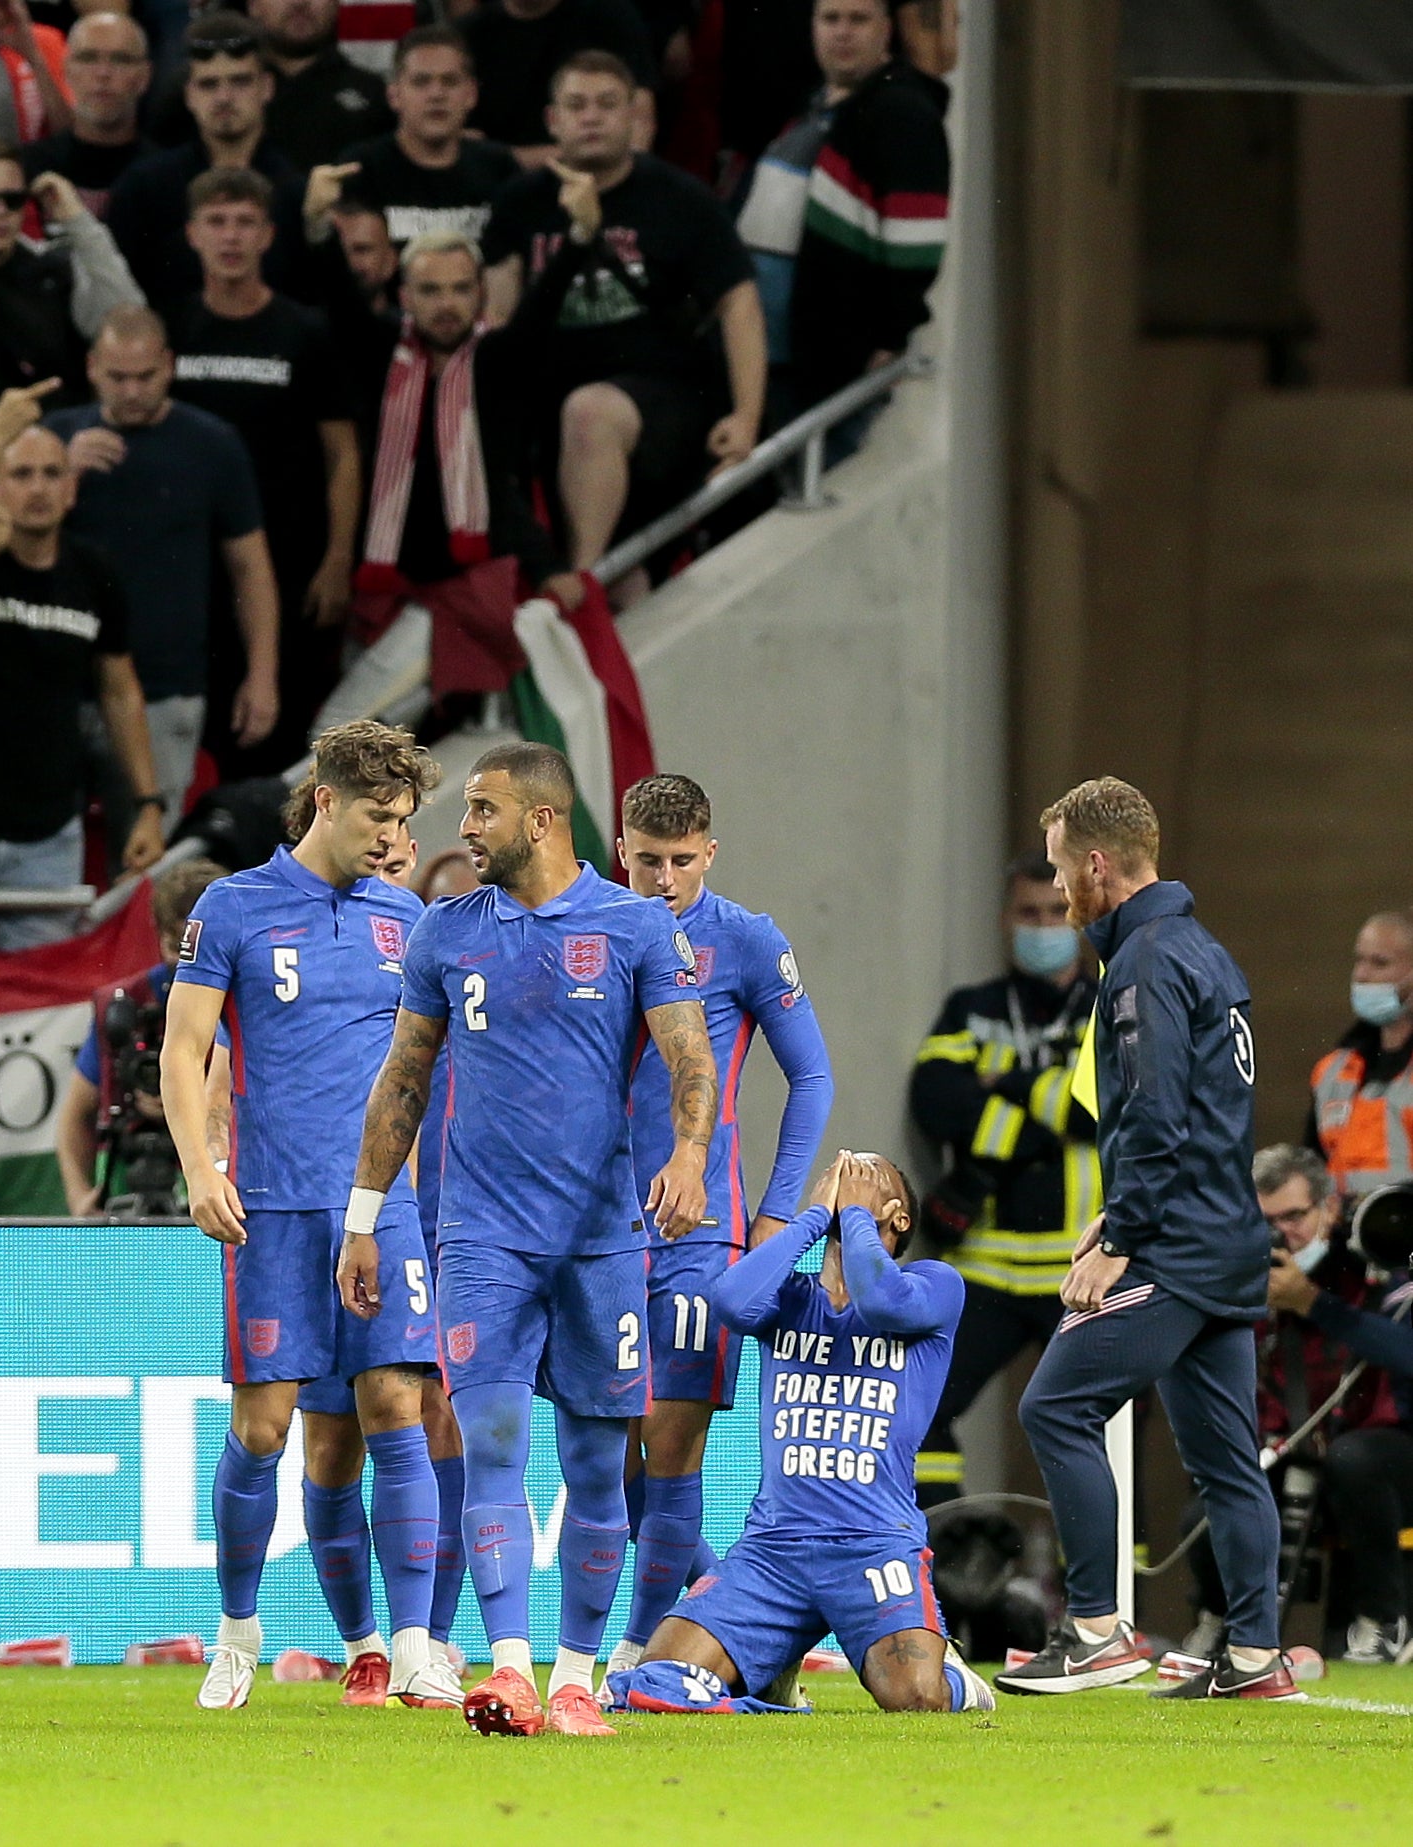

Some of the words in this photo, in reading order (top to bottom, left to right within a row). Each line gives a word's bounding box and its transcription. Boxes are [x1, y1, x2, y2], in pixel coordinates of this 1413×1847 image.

[273, 947, 300, 1003] 5
[463, 972, 487, 1031] 2
[403, 1259, 428, 1316] 5
[617, 1311, 640, 1371] 2
[673, 1293, 708, 1351] 11
[773, 1328, 834, 1366] LOVE
[851, 1336, 906, 1372] YOU
[773, 1372, 897, 1415] FOREVER
[773, 1407, 890, 1450] STEFFIE
[782, 1444, 877, 1485] GREGG
[863, 1558, 915, 1603] 10
